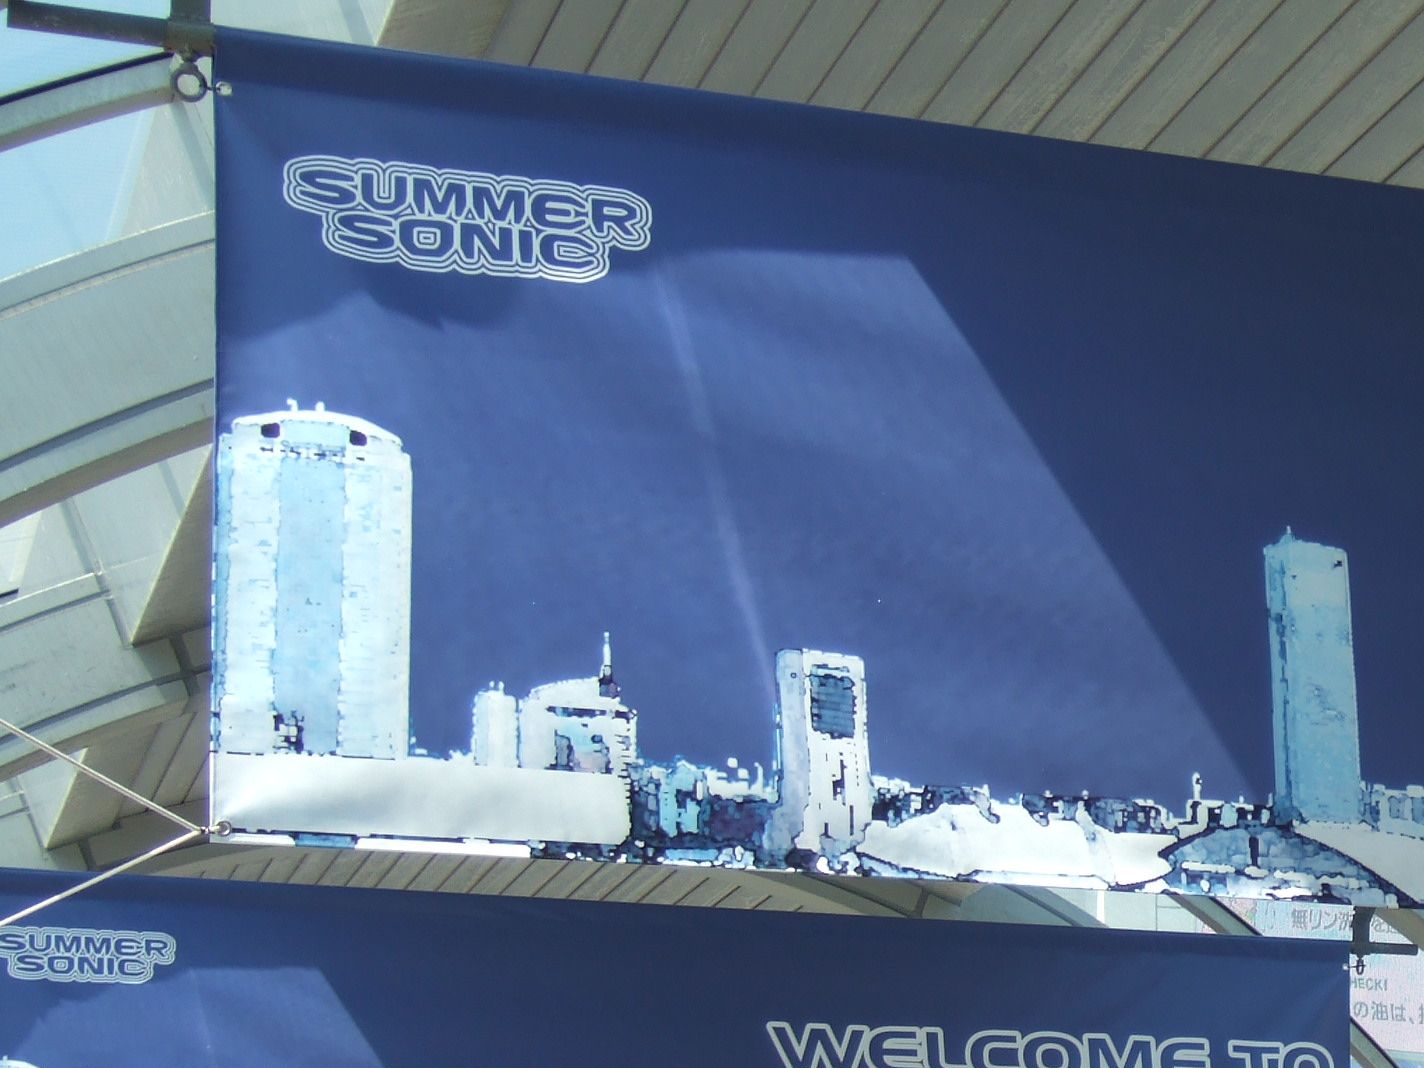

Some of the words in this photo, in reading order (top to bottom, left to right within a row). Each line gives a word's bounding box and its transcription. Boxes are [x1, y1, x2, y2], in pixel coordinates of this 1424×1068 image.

[289, 160, 648, 247] SUMMER
[327, 211, 607, 278] SONIC
[0, 928, 175, 963] SUMMER
[11, 954, 152, 982] SONIC
